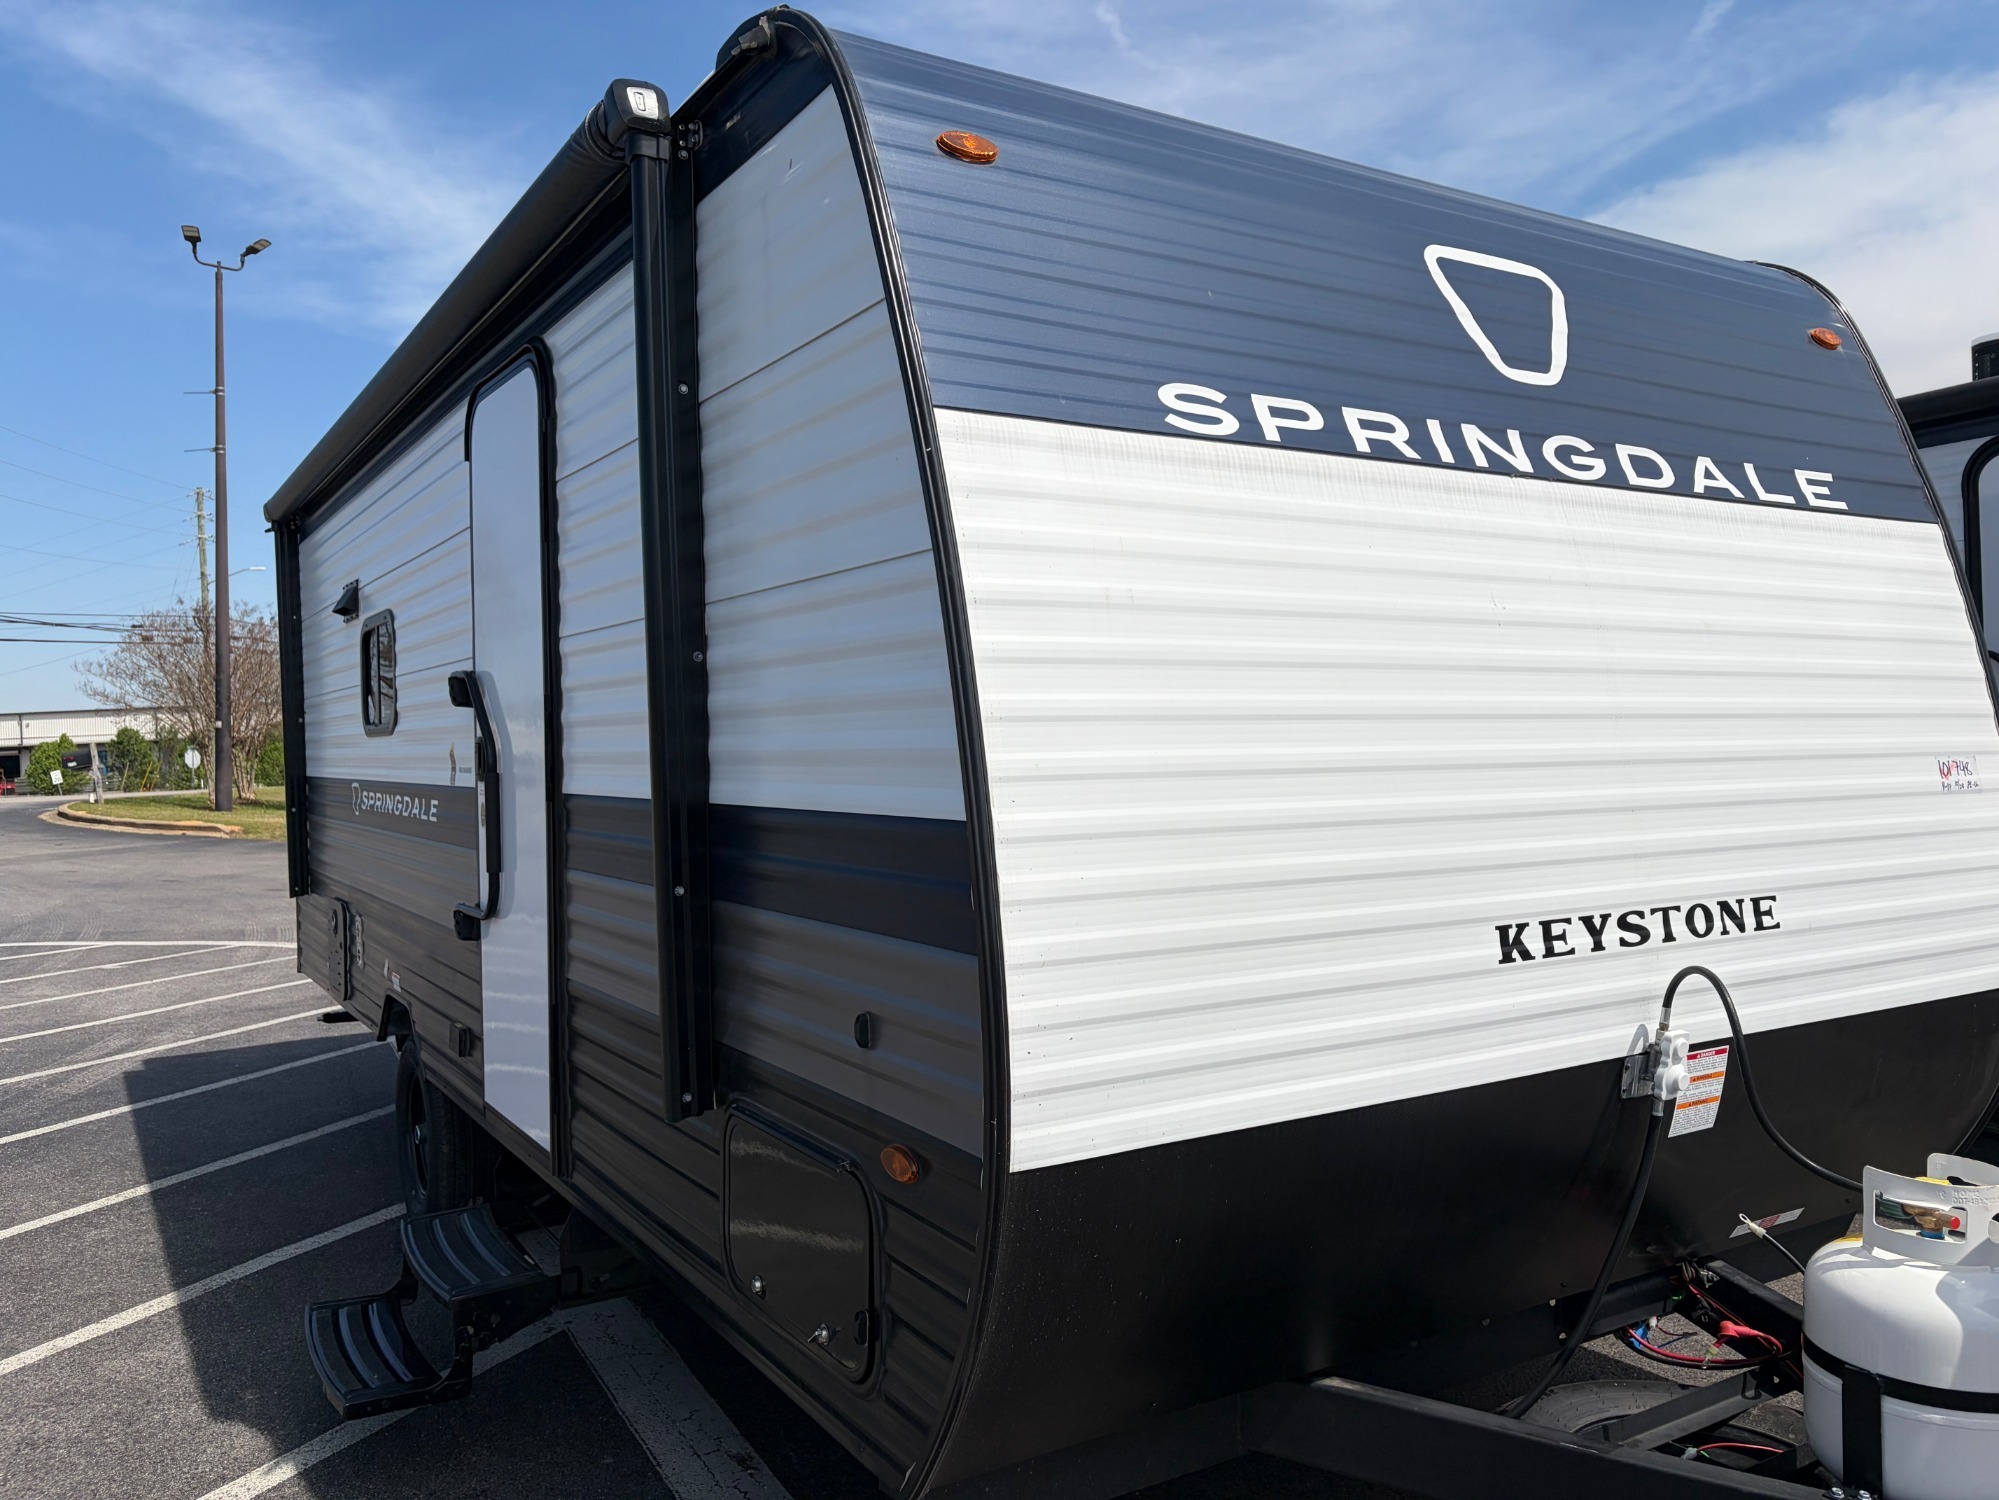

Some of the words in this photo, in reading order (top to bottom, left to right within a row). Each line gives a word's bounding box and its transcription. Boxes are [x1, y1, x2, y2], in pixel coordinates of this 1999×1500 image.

[1157, 382, 1848, 510] SPRINGDALE
[360, 790, 438, 822] SPRINGDALE
[1495, 895, 1781, 964] KEYSTONE
